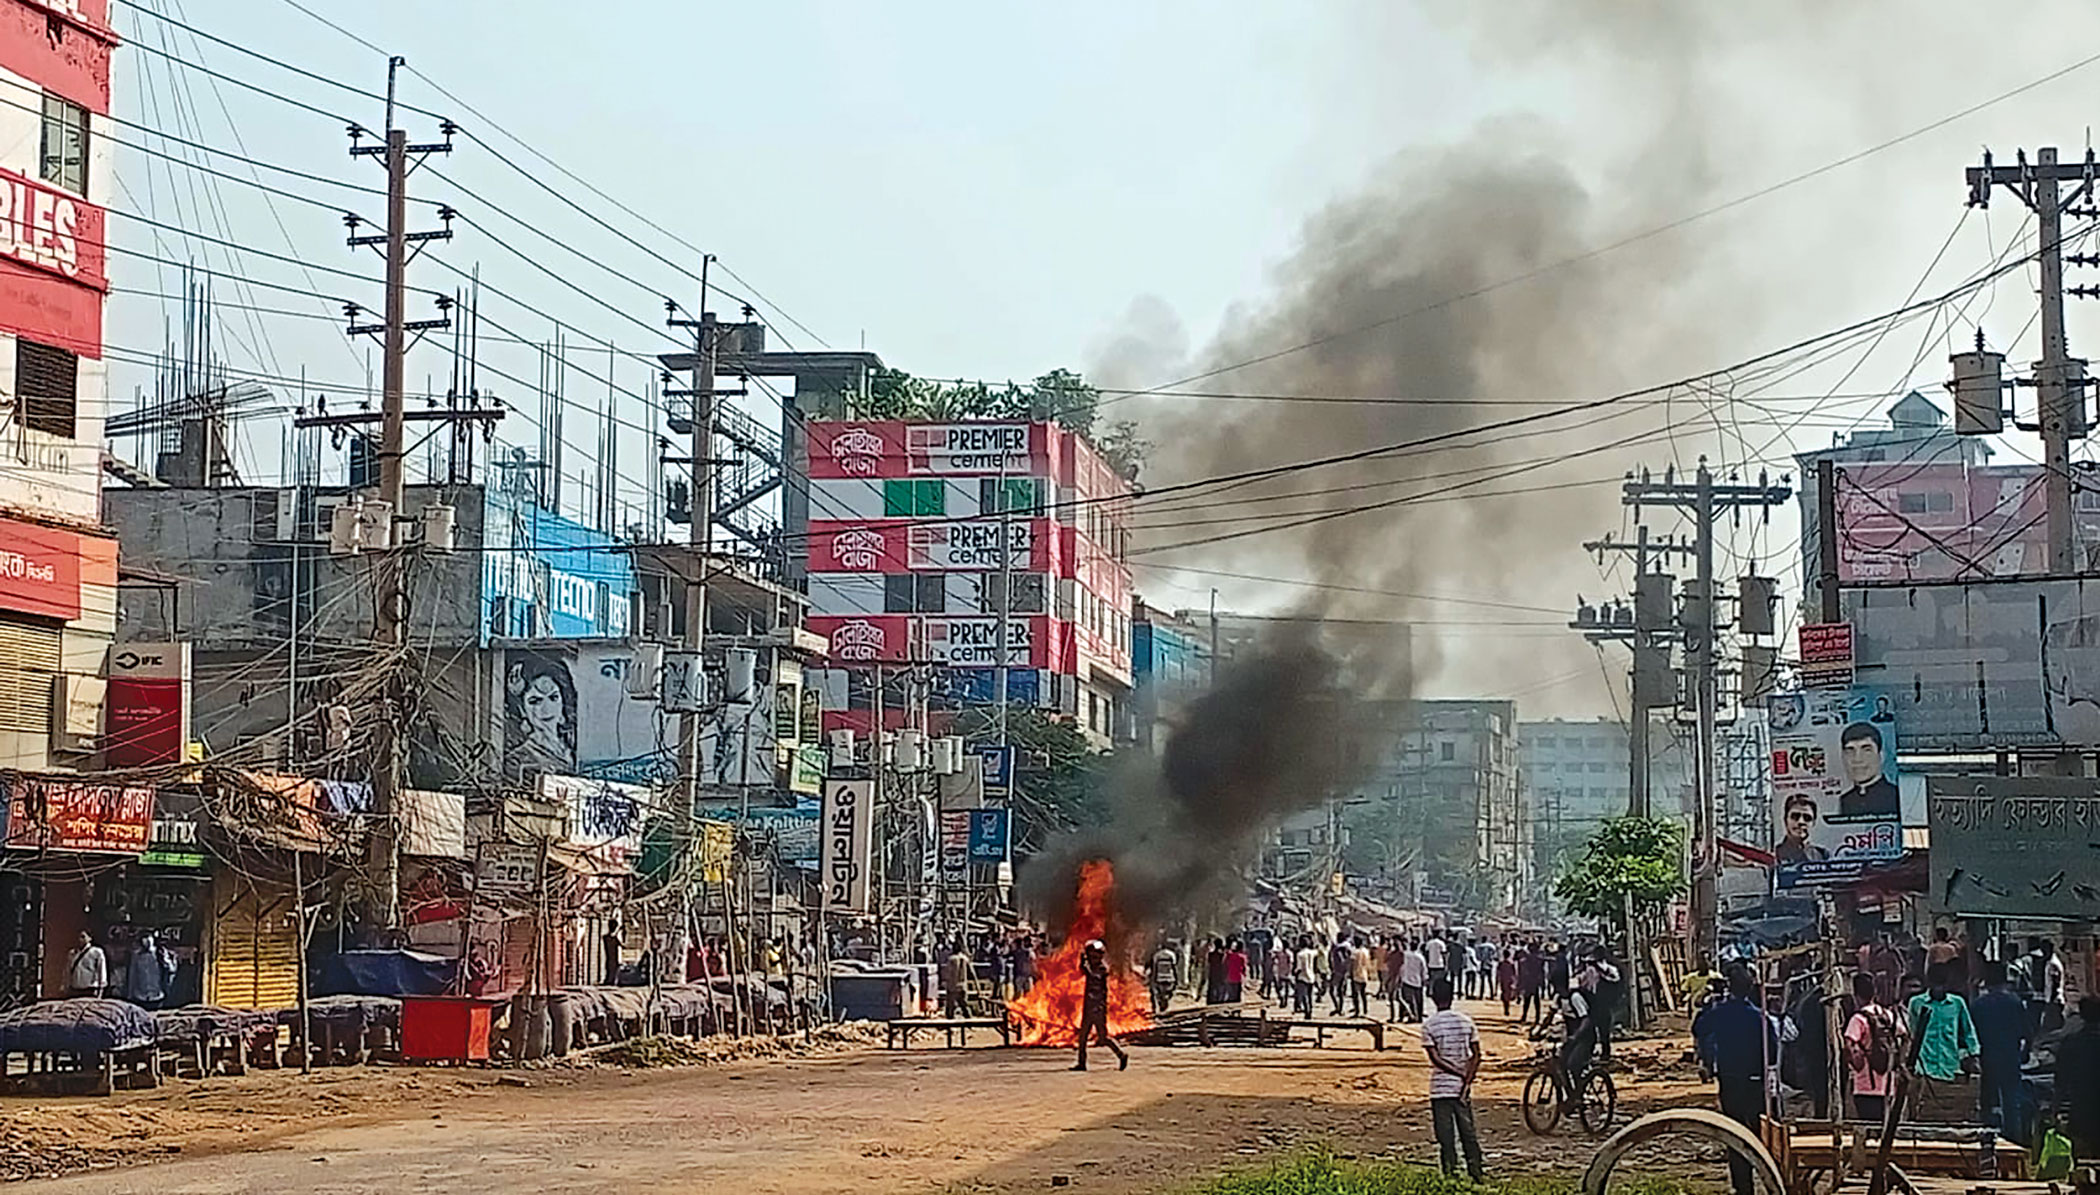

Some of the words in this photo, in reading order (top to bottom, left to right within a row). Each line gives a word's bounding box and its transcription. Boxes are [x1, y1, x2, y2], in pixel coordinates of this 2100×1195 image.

[948, 428, 1025, 450] PREMIER
[950, 623, 1025, 645] PREMER
[830, 785, 859, 907] ওয়ালটন
